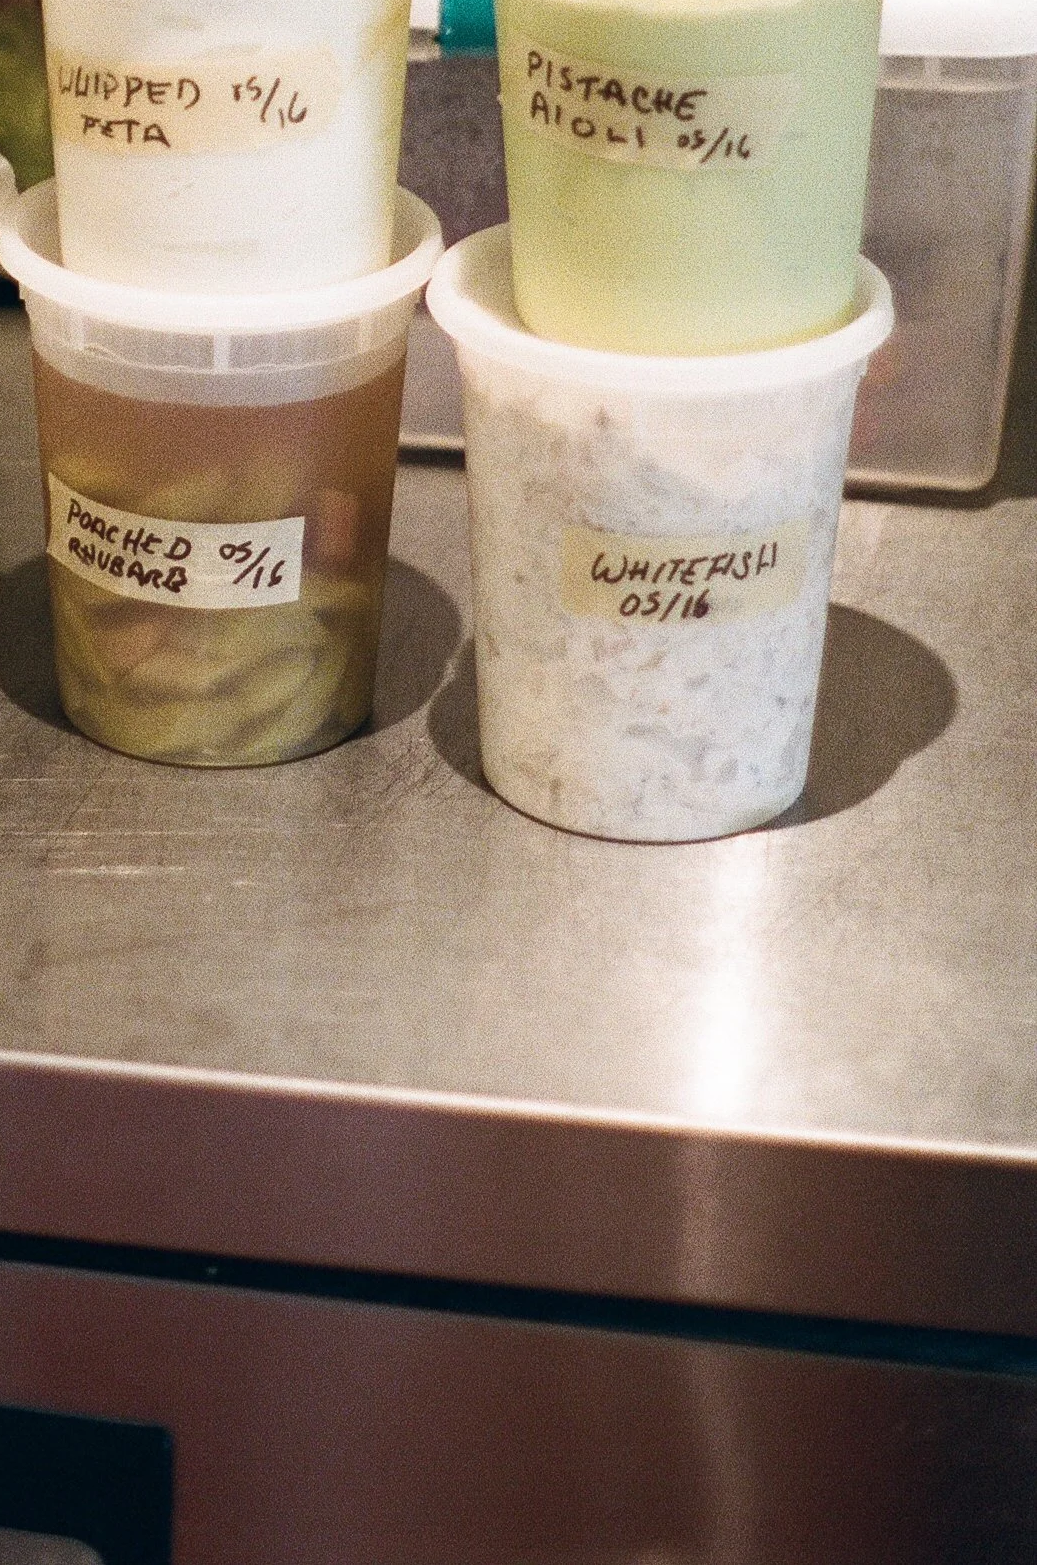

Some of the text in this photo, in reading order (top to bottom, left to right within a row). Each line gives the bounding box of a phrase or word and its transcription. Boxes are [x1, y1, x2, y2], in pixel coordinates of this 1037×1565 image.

[527, 49, 708, 122] PISTACHE
[530, 90, 646, 149] AIOLI
[591, 541, 778, 586] WHITEFISH
[619, 588, 710, 623] 05/16
